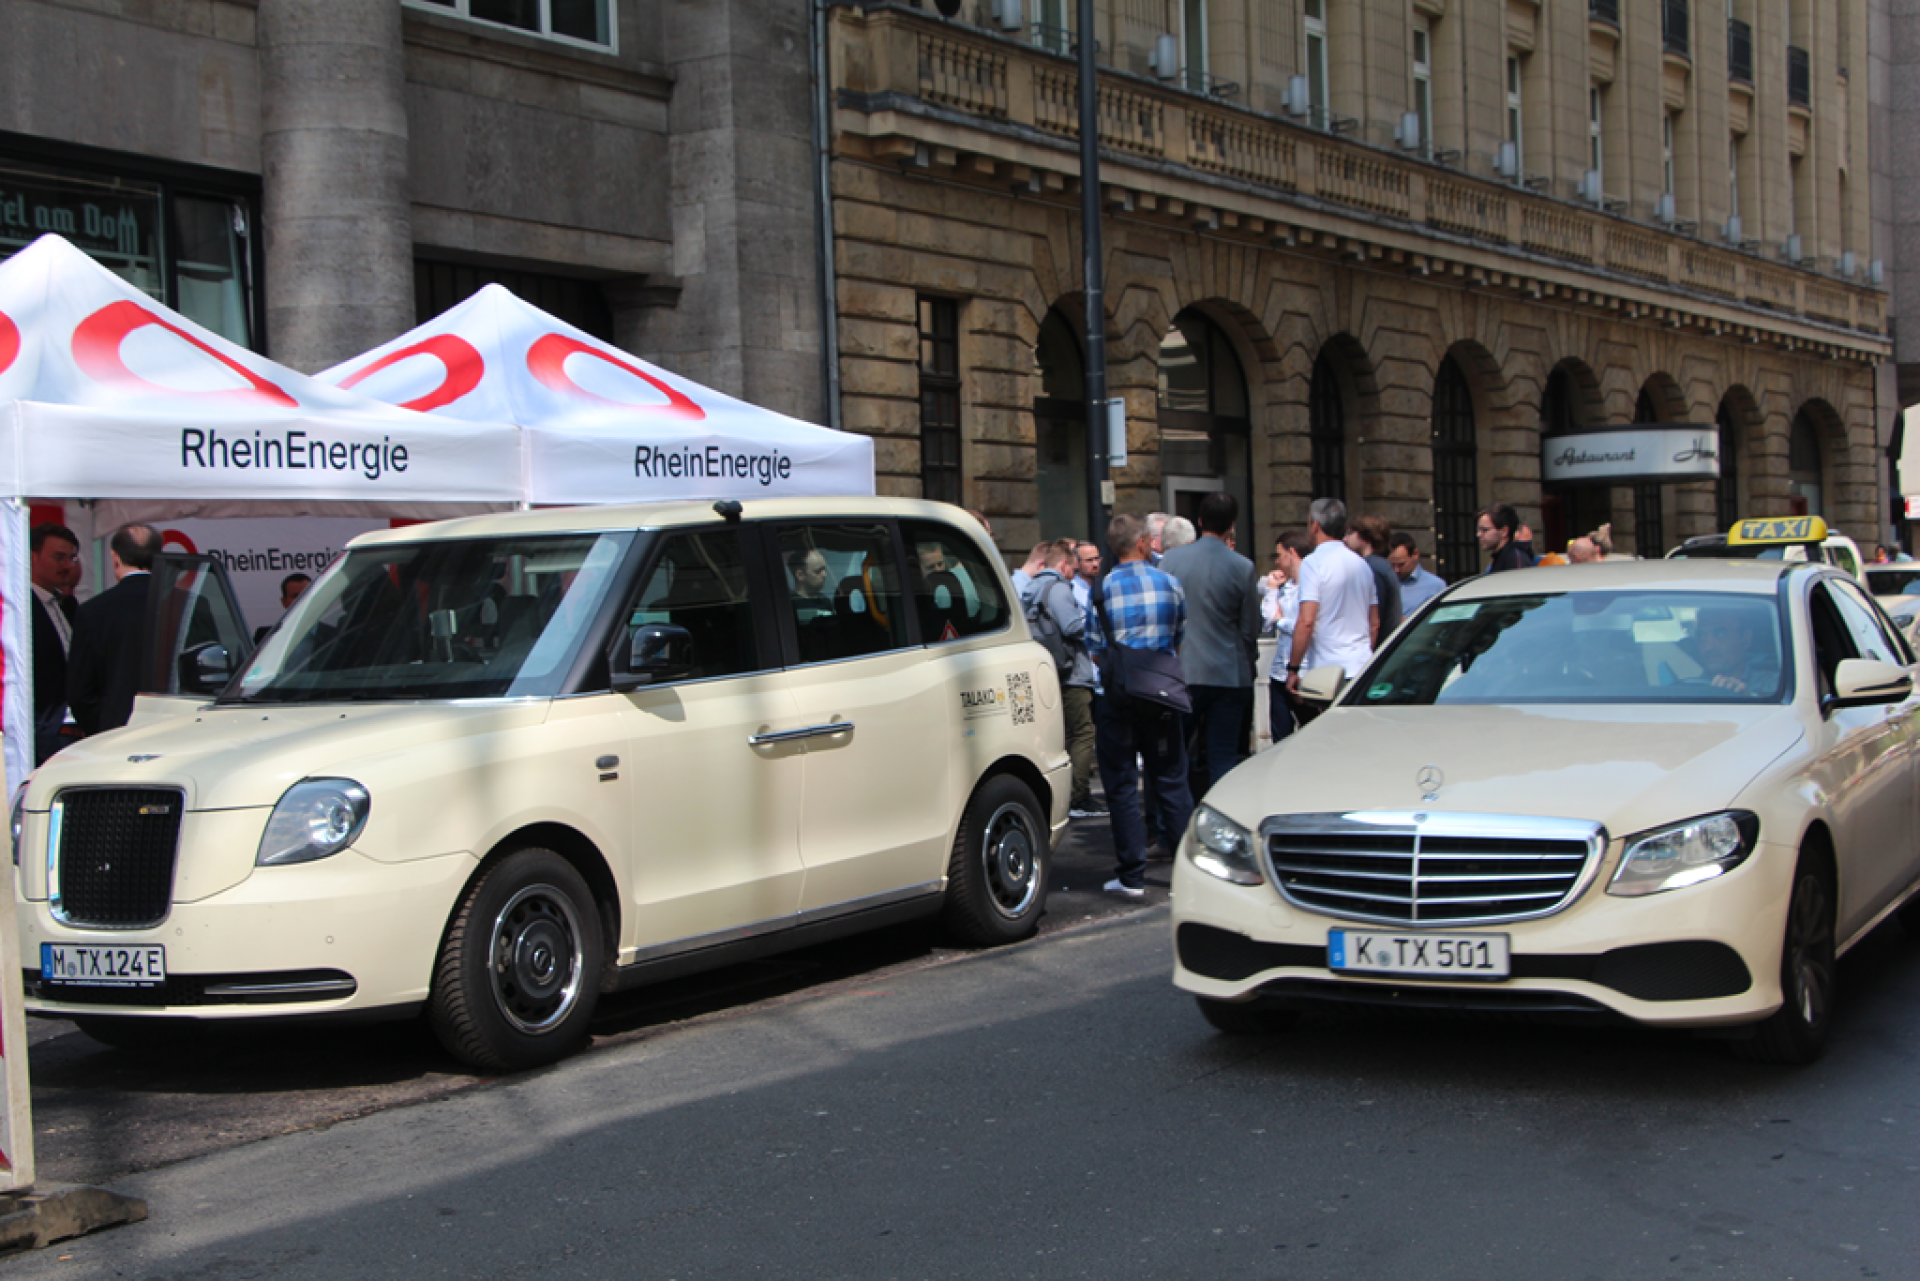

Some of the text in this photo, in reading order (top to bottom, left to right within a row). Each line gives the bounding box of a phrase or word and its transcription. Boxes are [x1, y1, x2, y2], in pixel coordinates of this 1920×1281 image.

[33, 204, 76, 234] am
[181, 427, 409, 480] RheinEnergie
[634, 445, 792, 486] RheinEnergie
[1744, 519, 1809, 539] TAXI
[207, 547, 338, 573] heinEnergi
[53, 948, 66, 976] M
[1356, 936, 1373, 965] K
[1437, 940, 1494, 969] 501
